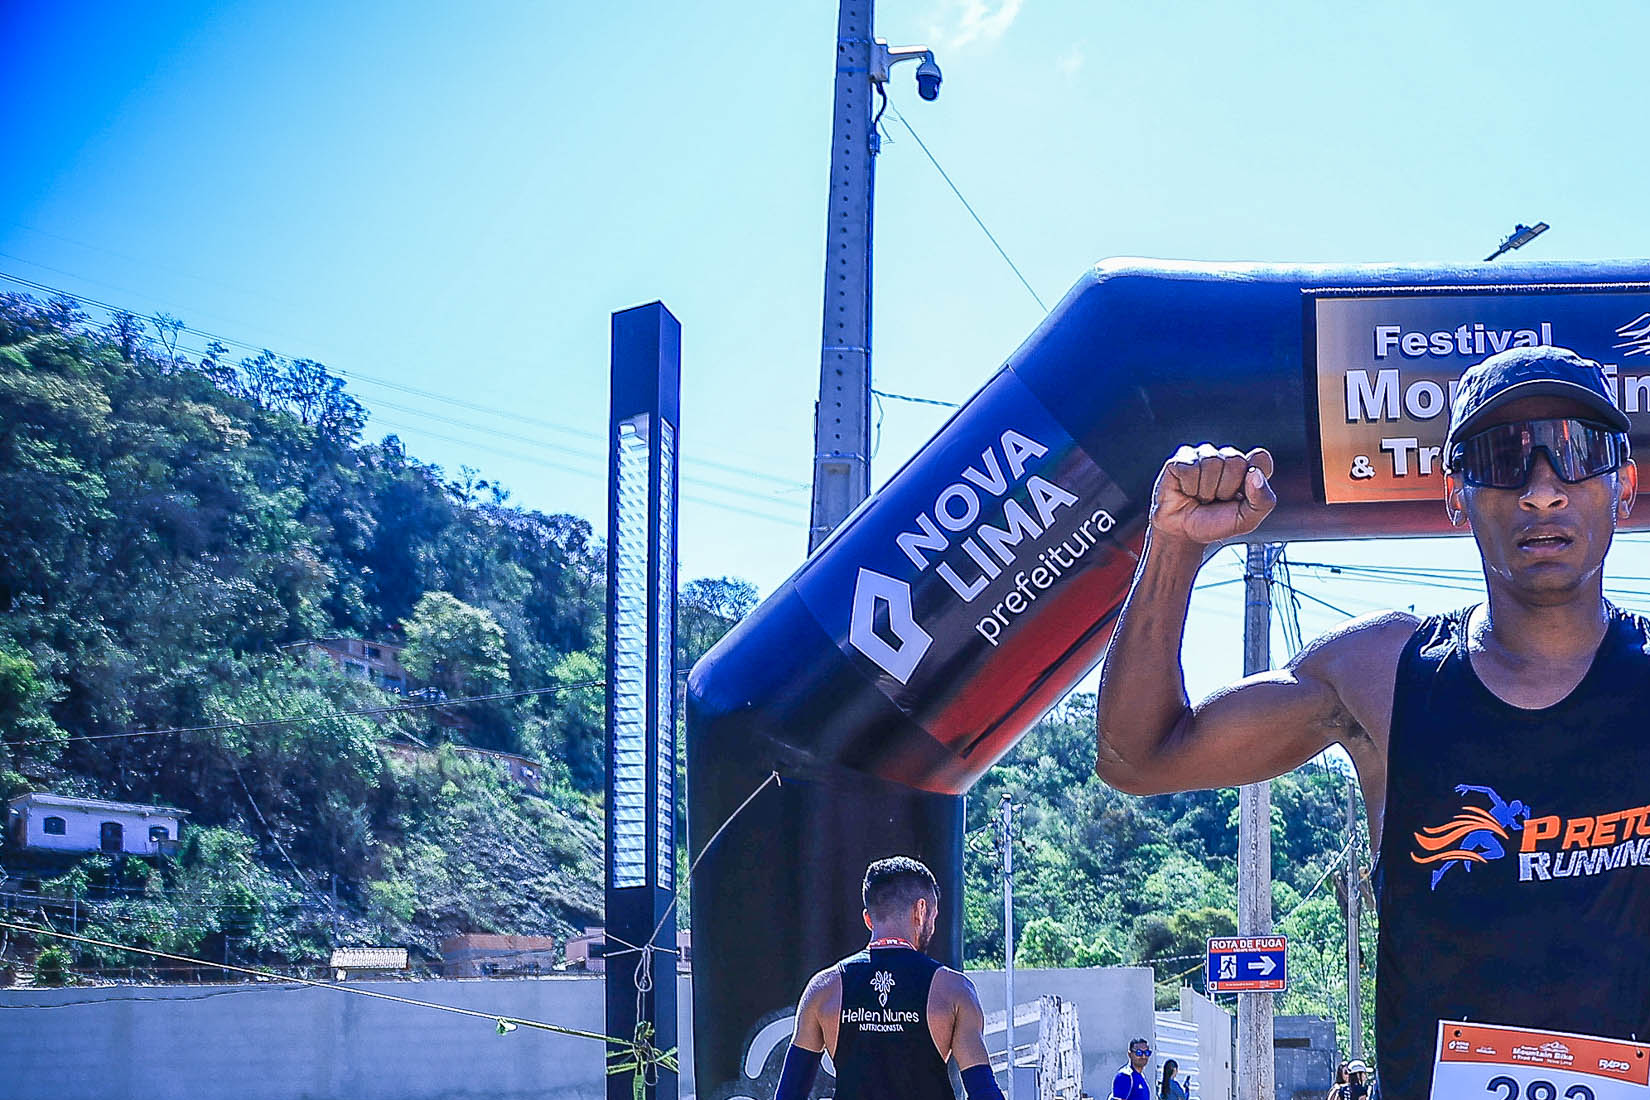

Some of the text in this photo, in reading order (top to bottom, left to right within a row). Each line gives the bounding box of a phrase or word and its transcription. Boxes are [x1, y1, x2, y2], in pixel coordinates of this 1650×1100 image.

[1375, 322, 1552, 357] Festival
[1351, 455, 1375, 478] &
[895, 429, 1049, 572] NOVA
[935, 475, 1080, 603] LIMA
[975, 508, 1117, 647] prefeitura
[1211, 938, 1283, 949] ROTA DE FUGA
[842, 1008, 919, 1023] Hellen Nunes
